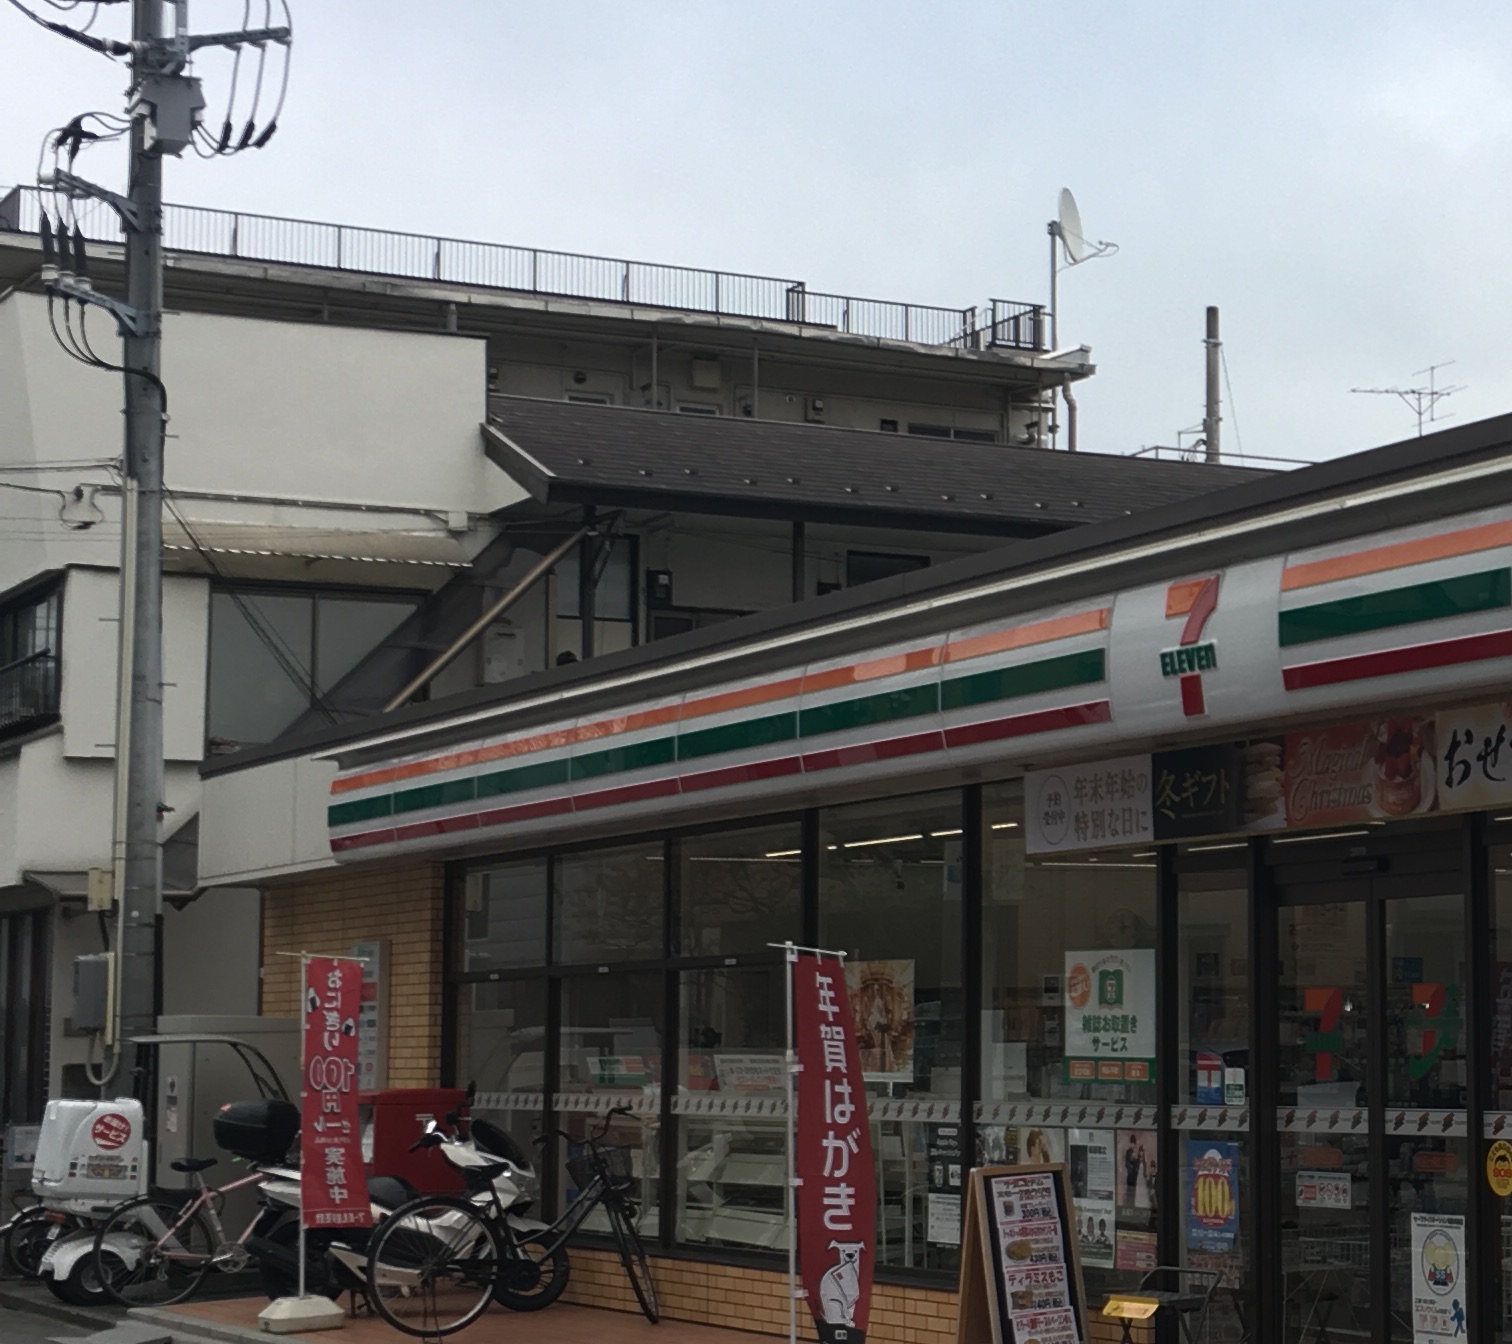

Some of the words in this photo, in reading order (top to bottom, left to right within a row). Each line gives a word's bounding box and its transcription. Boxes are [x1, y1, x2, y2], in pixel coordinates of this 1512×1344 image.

[1165, 573, 1220, 716] 7
[1291, 734, 1370, 780] Magical
[1073, 768, 1148, 806] 年末年始の
[1157, 768, 1230, 820] 冬ギフト
[1290, 778, 1373, 822] Christmas
[1074, 806, 1149, 842] 特別な日に
[1082, 1014, 1138, 1034] 雑誌お取置き
[1092, 1036, 1128, 1053] サービス
[814, 971, 861, 1232] 年賀はがき
